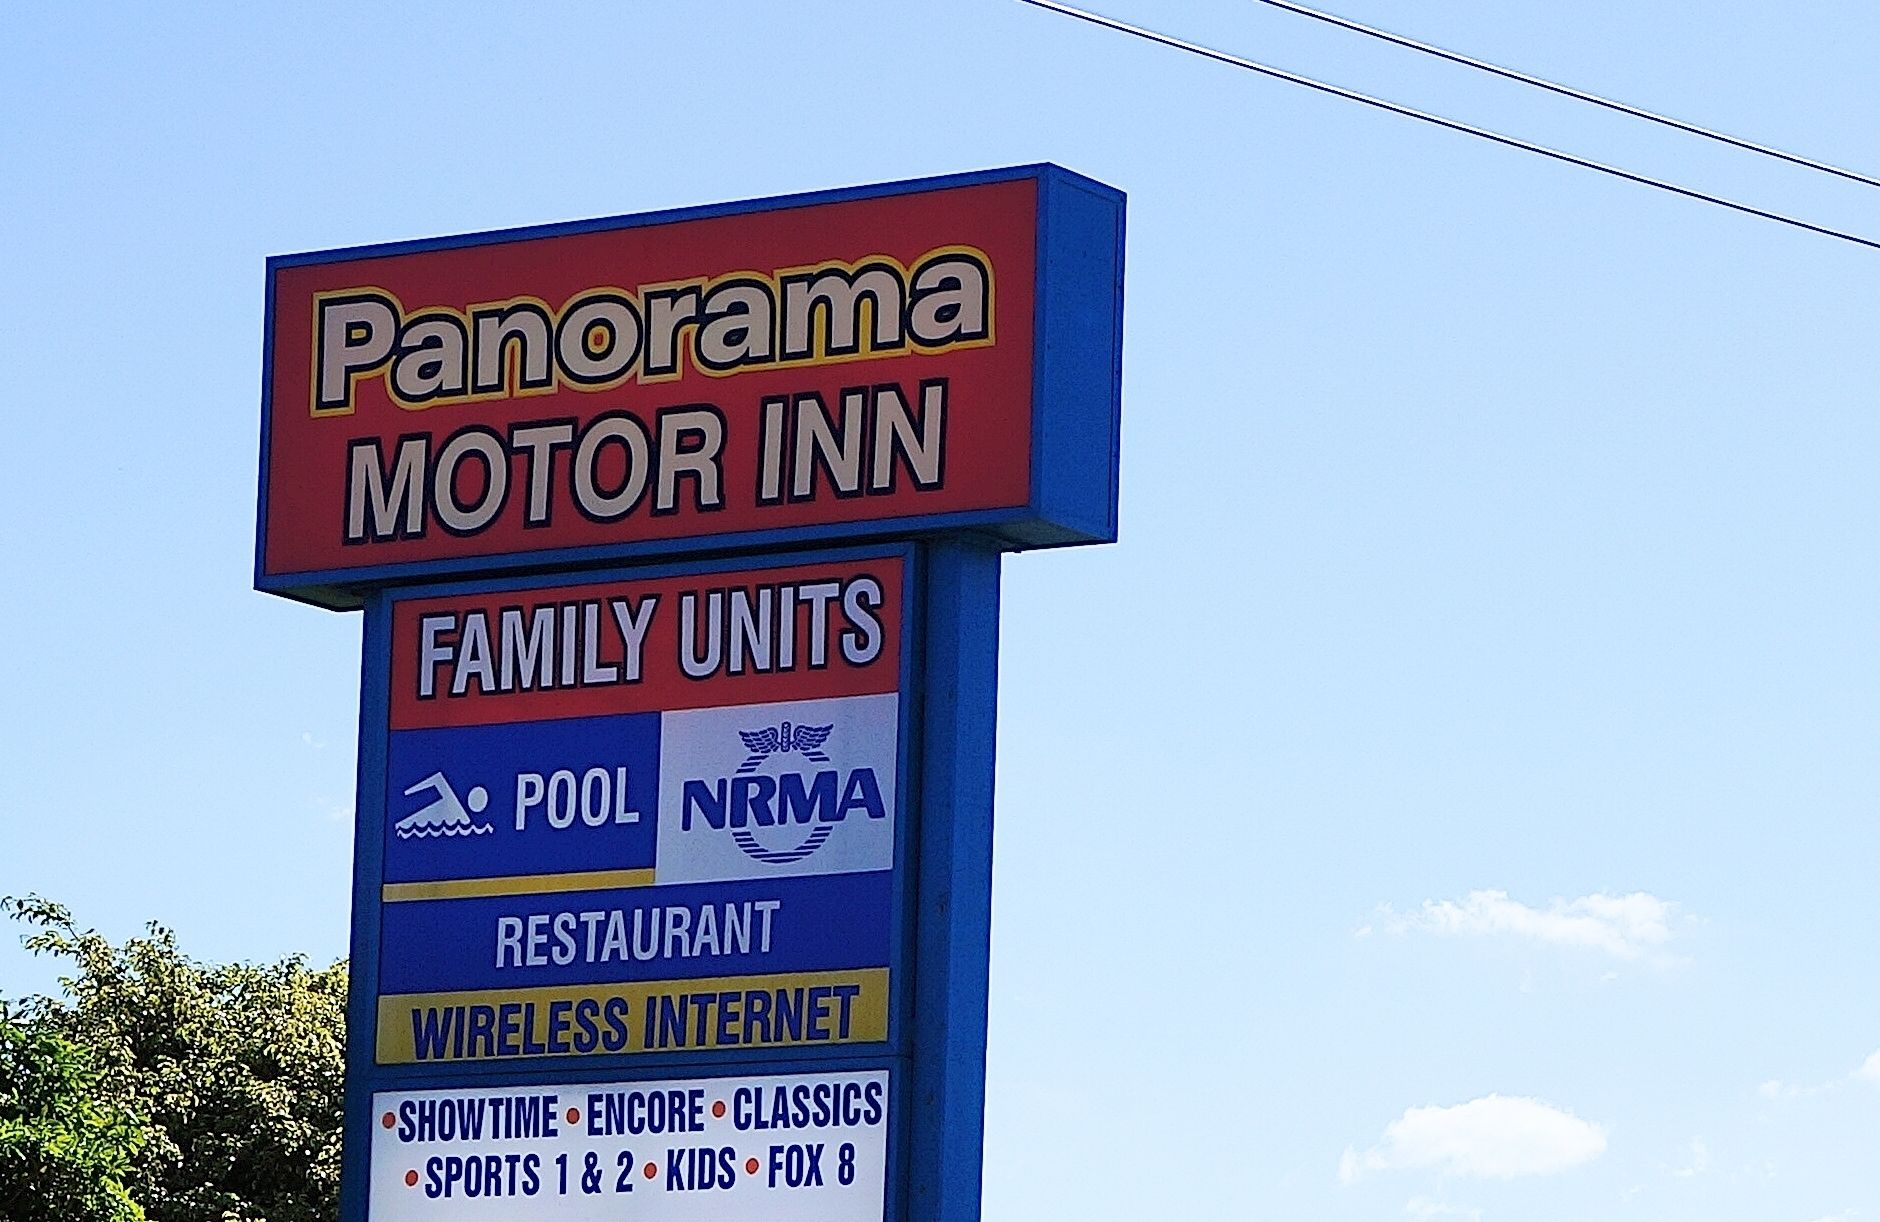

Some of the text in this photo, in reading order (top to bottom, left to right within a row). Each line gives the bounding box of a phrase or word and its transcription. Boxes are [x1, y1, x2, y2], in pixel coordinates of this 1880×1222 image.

[312, 247, 994, 415] Panorama
[344, 378, 949, 545] MOTOR INN
[417, 574, 886, 701] FAMILY UNITS
[515, 767, 640, 830] POOL
[682, 768, 885, 831] NRMA
[495, 901, 781, 968] RESTAURANT
[412, 985, 860, 1061] WIRELESS INTERNET
[398, 1082, 883, 1142] SHOWTIME ENCORE CLASSICS
[424, 1143, 856, 1198] SPORTS 1 & 2 KIDS FOX 8
